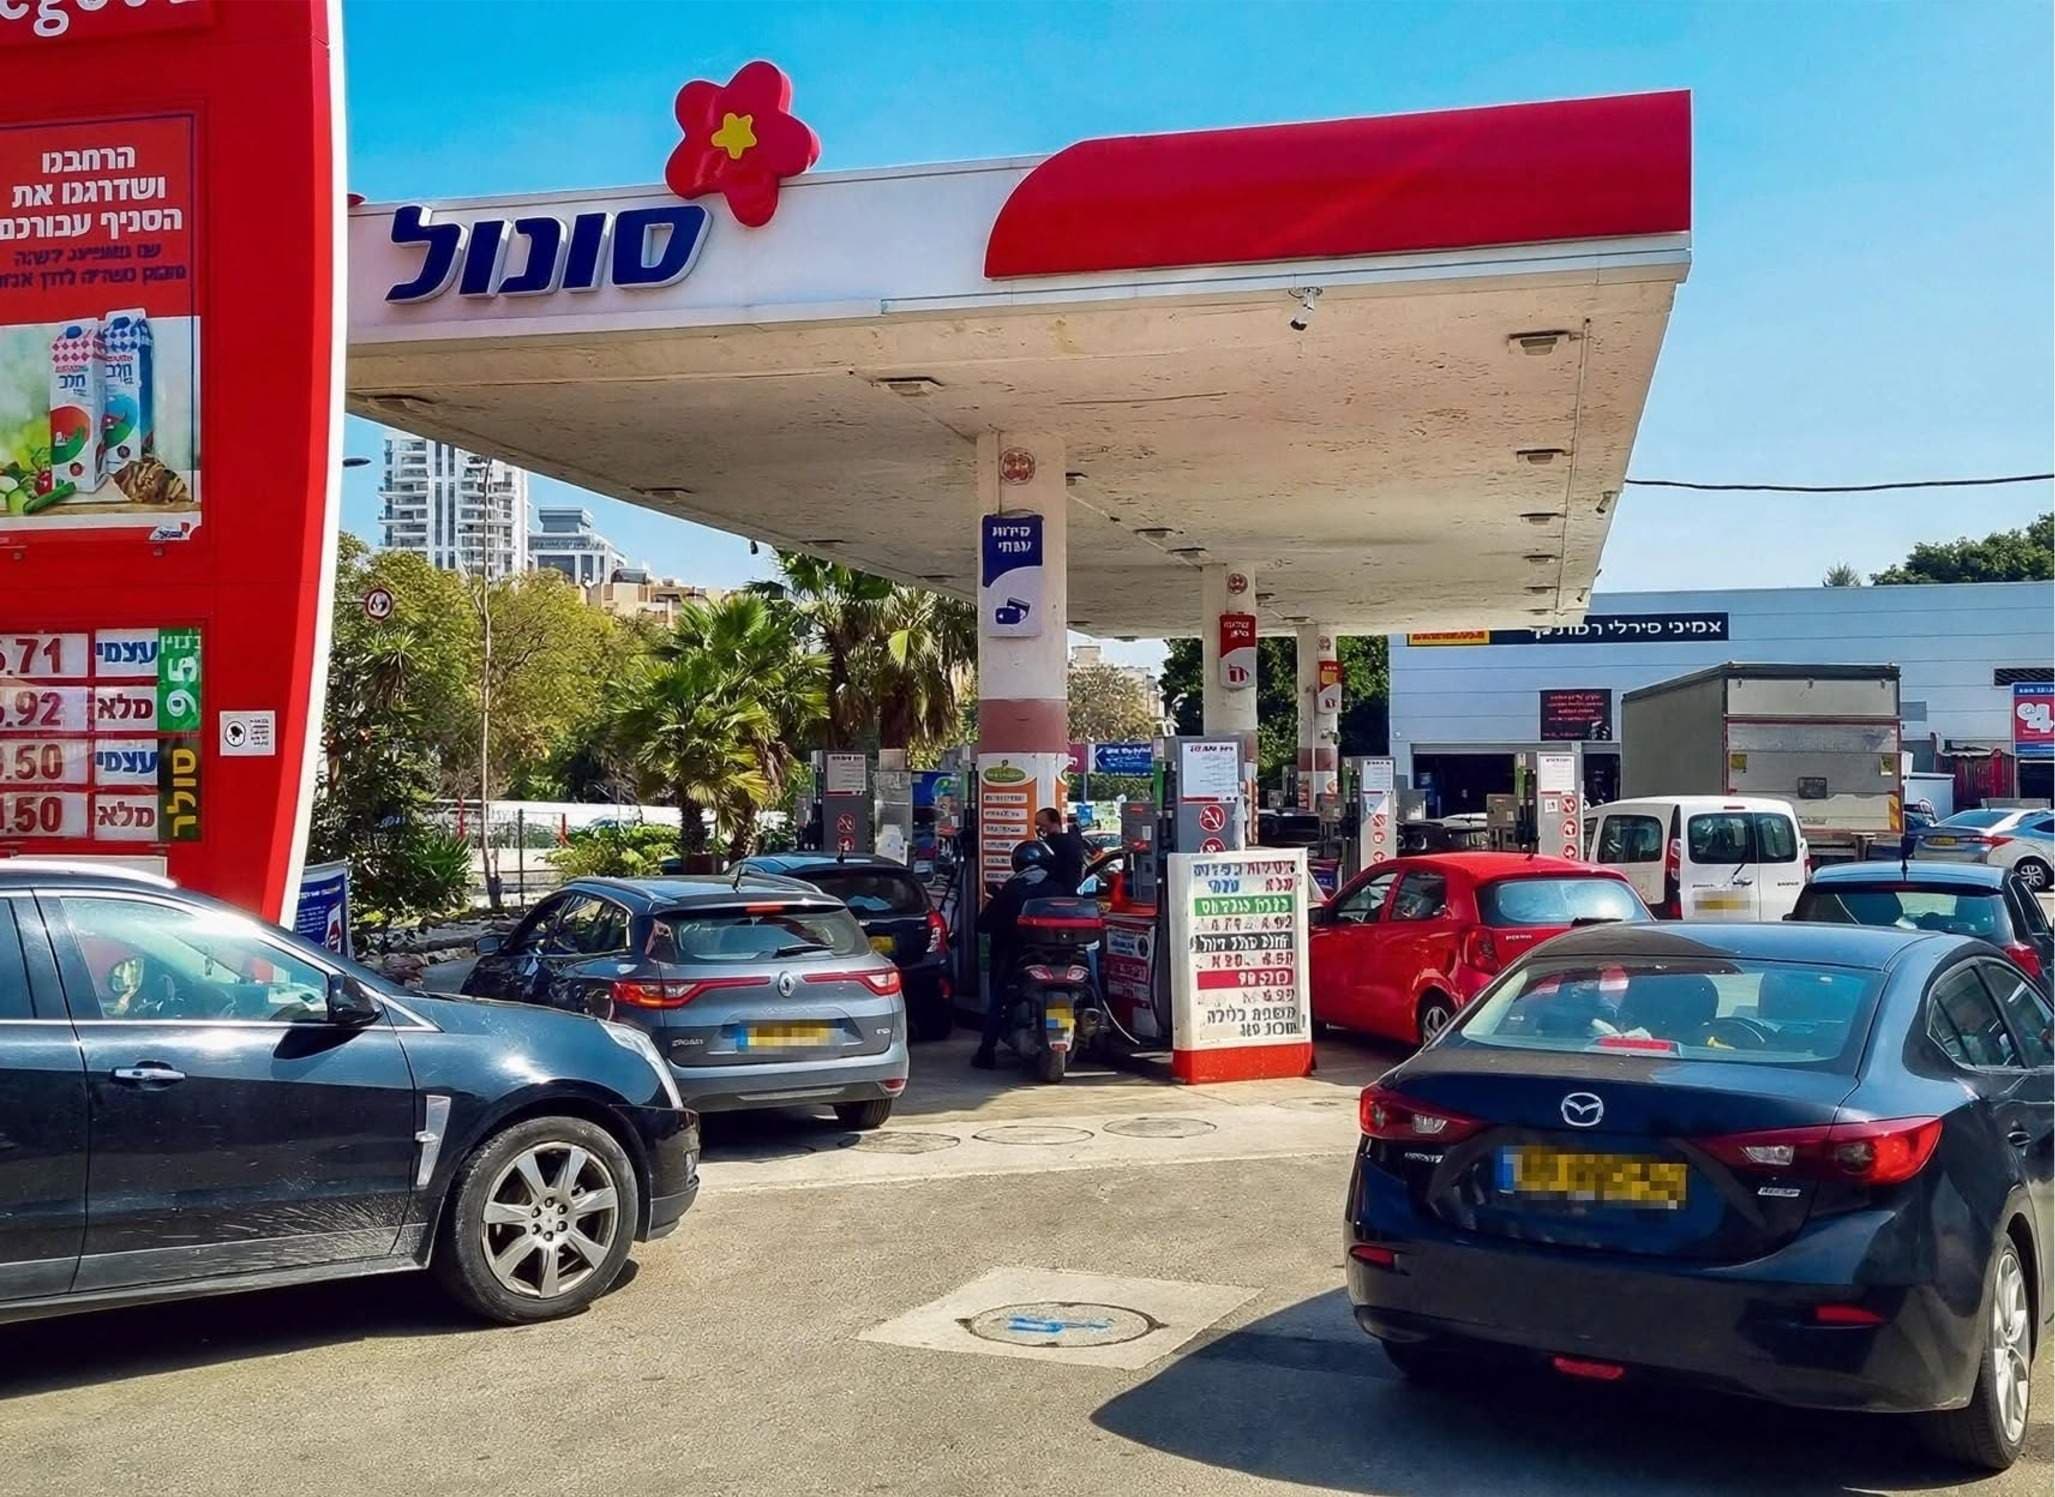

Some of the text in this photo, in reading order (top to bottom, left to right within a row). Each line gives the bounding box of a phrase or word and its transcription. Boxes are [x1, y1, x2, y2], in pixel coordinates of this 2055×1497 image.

[42, 146, 136, 173] הרחבנו
[12, 176, 166, 208] ושדרגנו את
[0, 208, 183, 240] הסניף עבורכם
[386, 204, 712, 303] סונול
[58, 373, 87, 389] חלב
[0, 638, 158, 675] .71 עצמי
[0, 691, 153, 727] .92 מלא
[0, 744, 159, 780] .50 עצמי
[166, 748, 196, 837] סולר
[0, 796, 155, 833] .50 מלא
